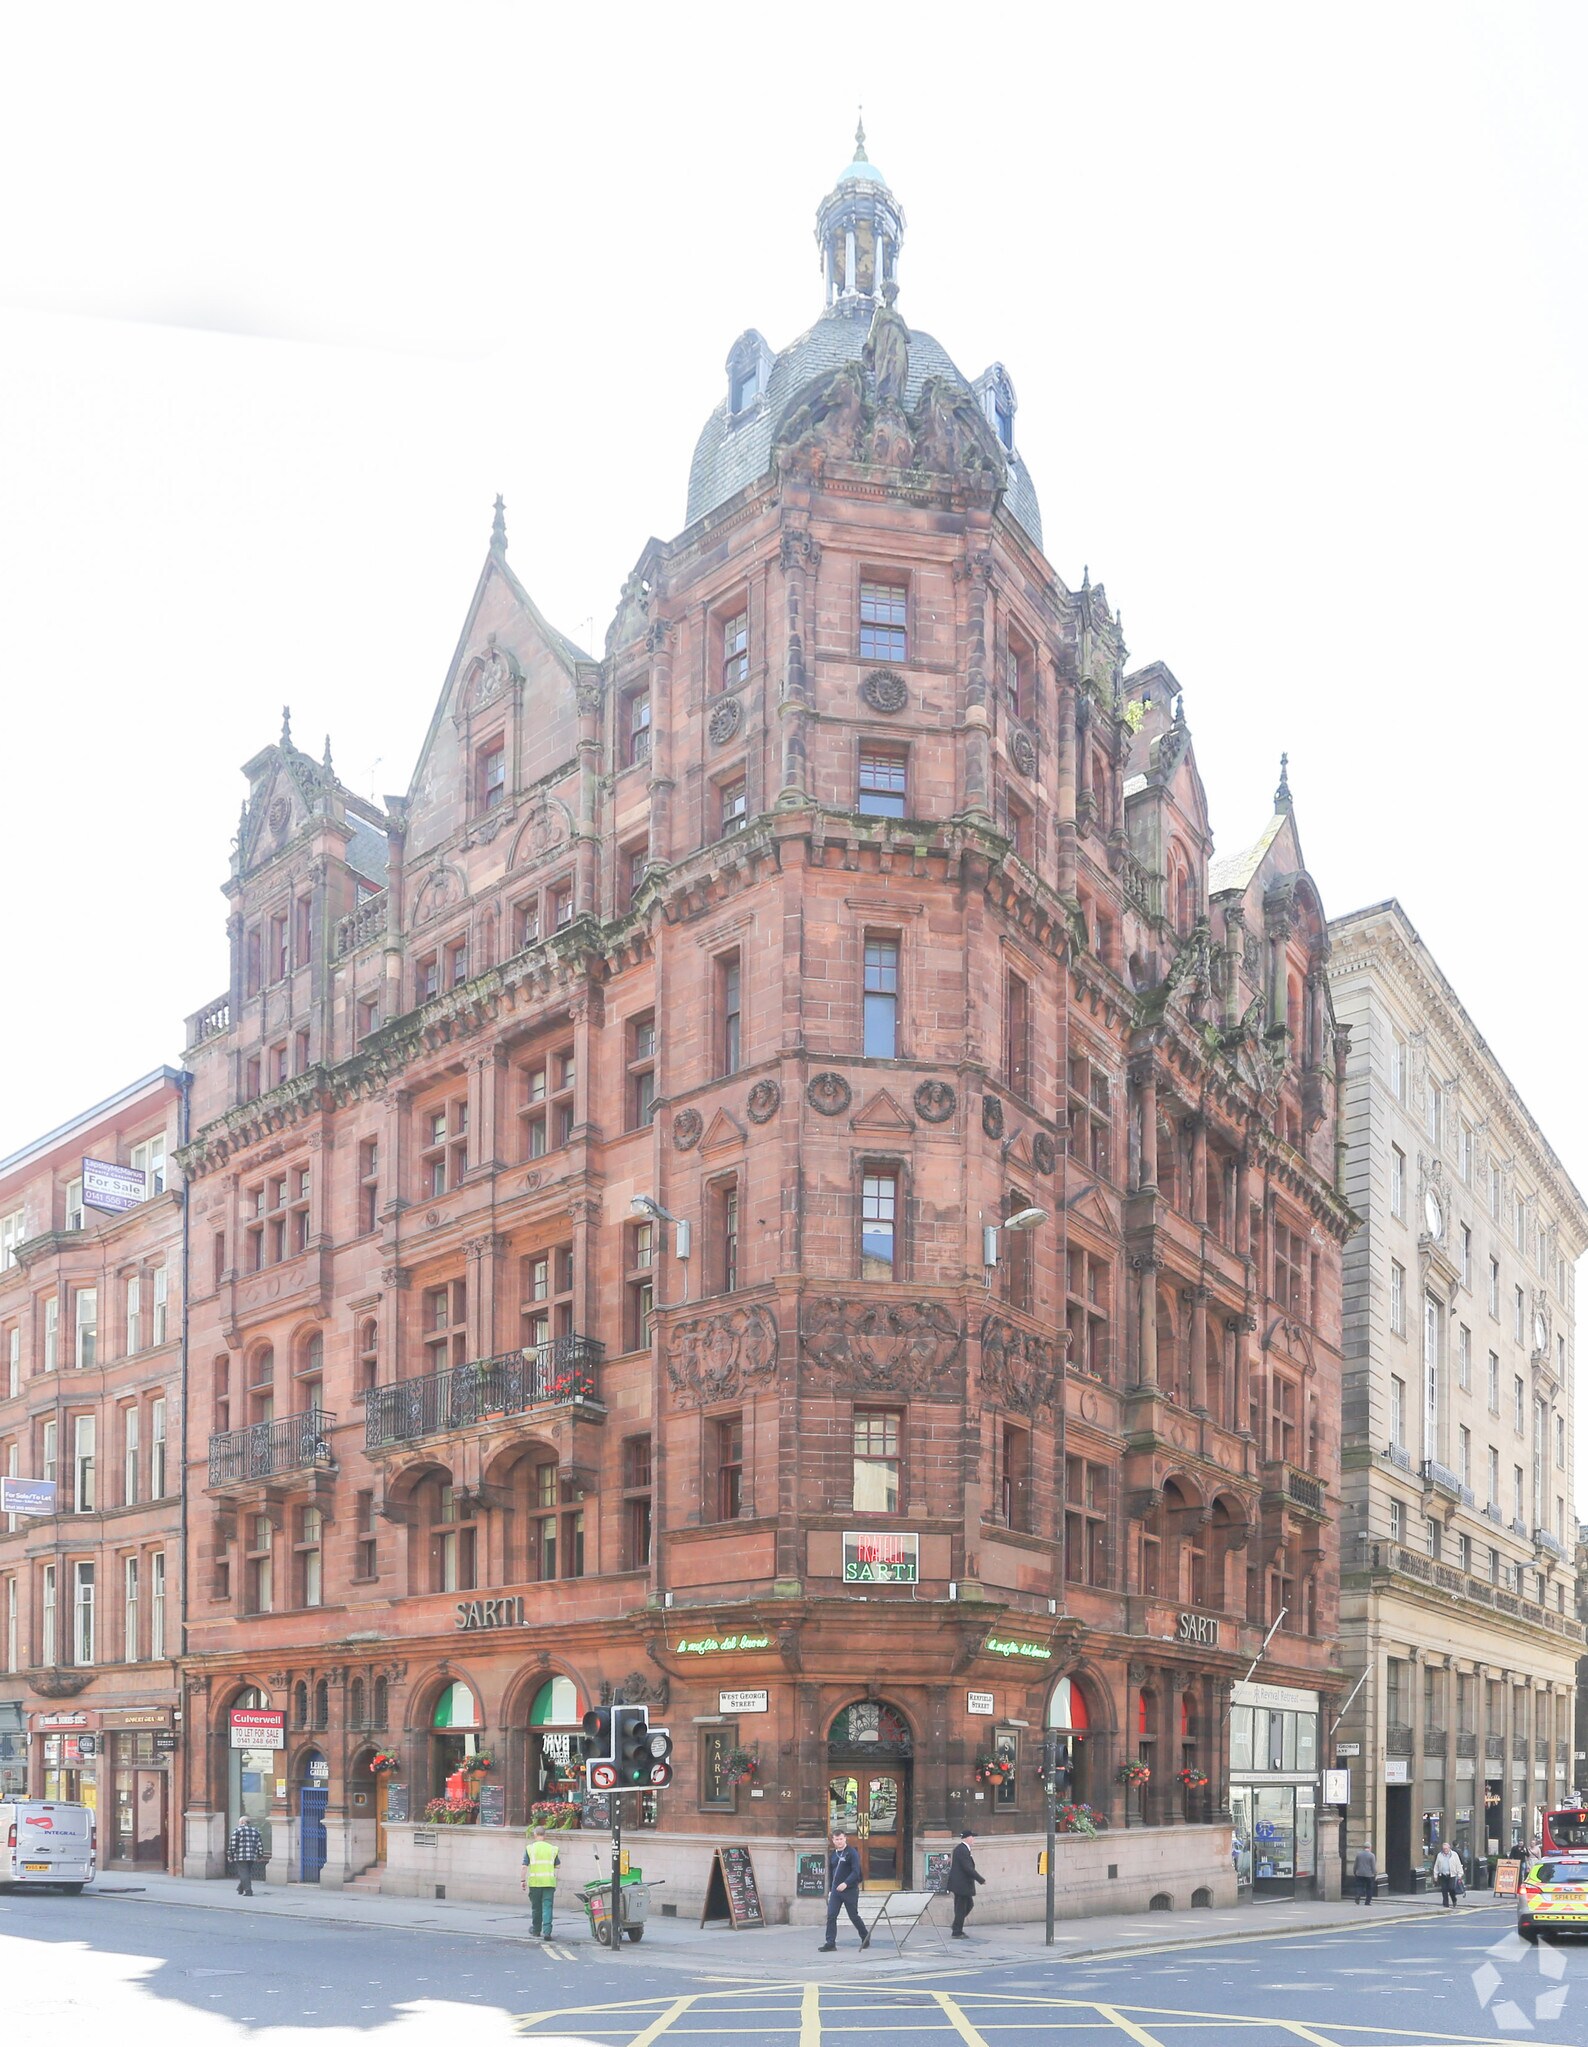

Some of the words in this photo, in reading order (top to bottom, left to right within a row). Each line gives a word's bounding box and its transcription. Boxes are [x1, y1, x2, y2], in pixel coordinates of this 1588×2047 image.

[88, 1174, 109, 1187] For
[113, 1180, 141, 1195] Sale
[85, 1190, 103, 1201] 0141
[857, 1534, 905, 1564] FRATELLI
[846, 1563, 915, 1581] SARTI
[454, 1595, 522, 1629] SARTI
[1179, 1612, 1220, 1645] SARTI
[720, 1635, 737, 1651] del
[721, 1693, 738, 1701] WEST
[740, 1692, 766, 1700] GEORGE
[969, 1693, 993, 1702] RENFIELD
[971, 1701, 990, 1710] STREET
[233, 1714, 281, 1724] Culverwell
[236, 1728, 243, 1737] TO
[244, 1728, 253, 1738] LET
[255, 1729, 265, 1738] FOR
[266, 1729, 279, 1739] SALE
[781, 1790, 792, 1798] 42
[950, 1791, 961, 1799] 42
